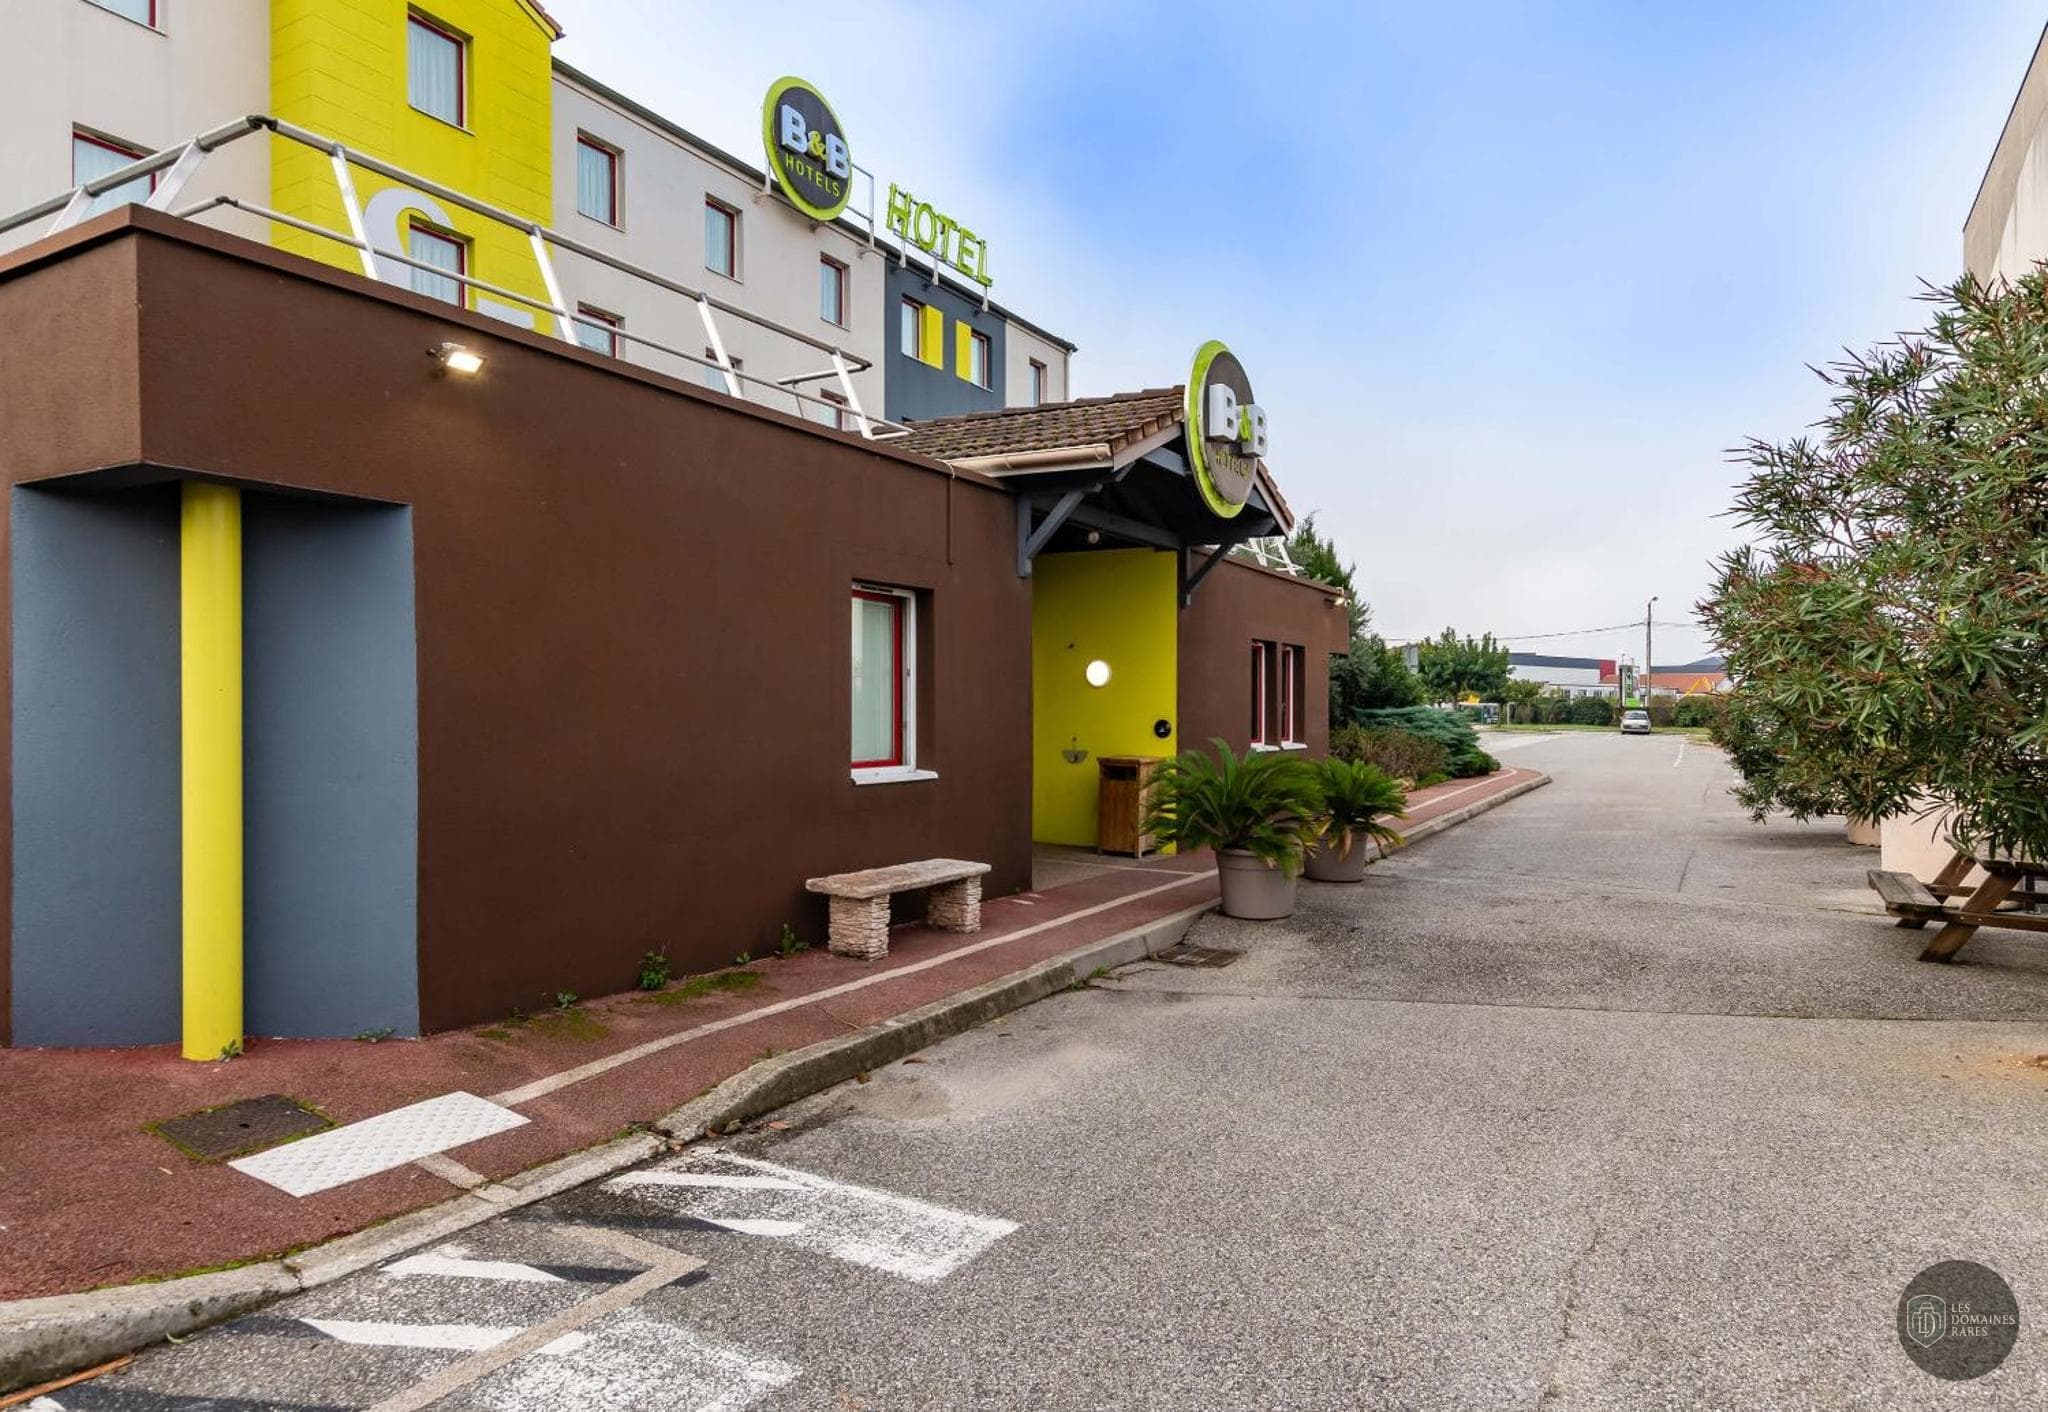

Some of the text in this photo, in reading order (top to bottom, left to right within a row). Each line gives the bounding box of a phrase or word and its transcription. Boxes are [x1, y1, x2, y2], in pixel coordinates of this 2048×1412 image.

[781, 104, 850, 179] B&B
[784, 154, 841, 198] HOTELS
[886, 182, 993, 287] HOTEL
[1209, 383, 1268, 458] B&B
[1215, 447, 1250, 479] HOTELS
